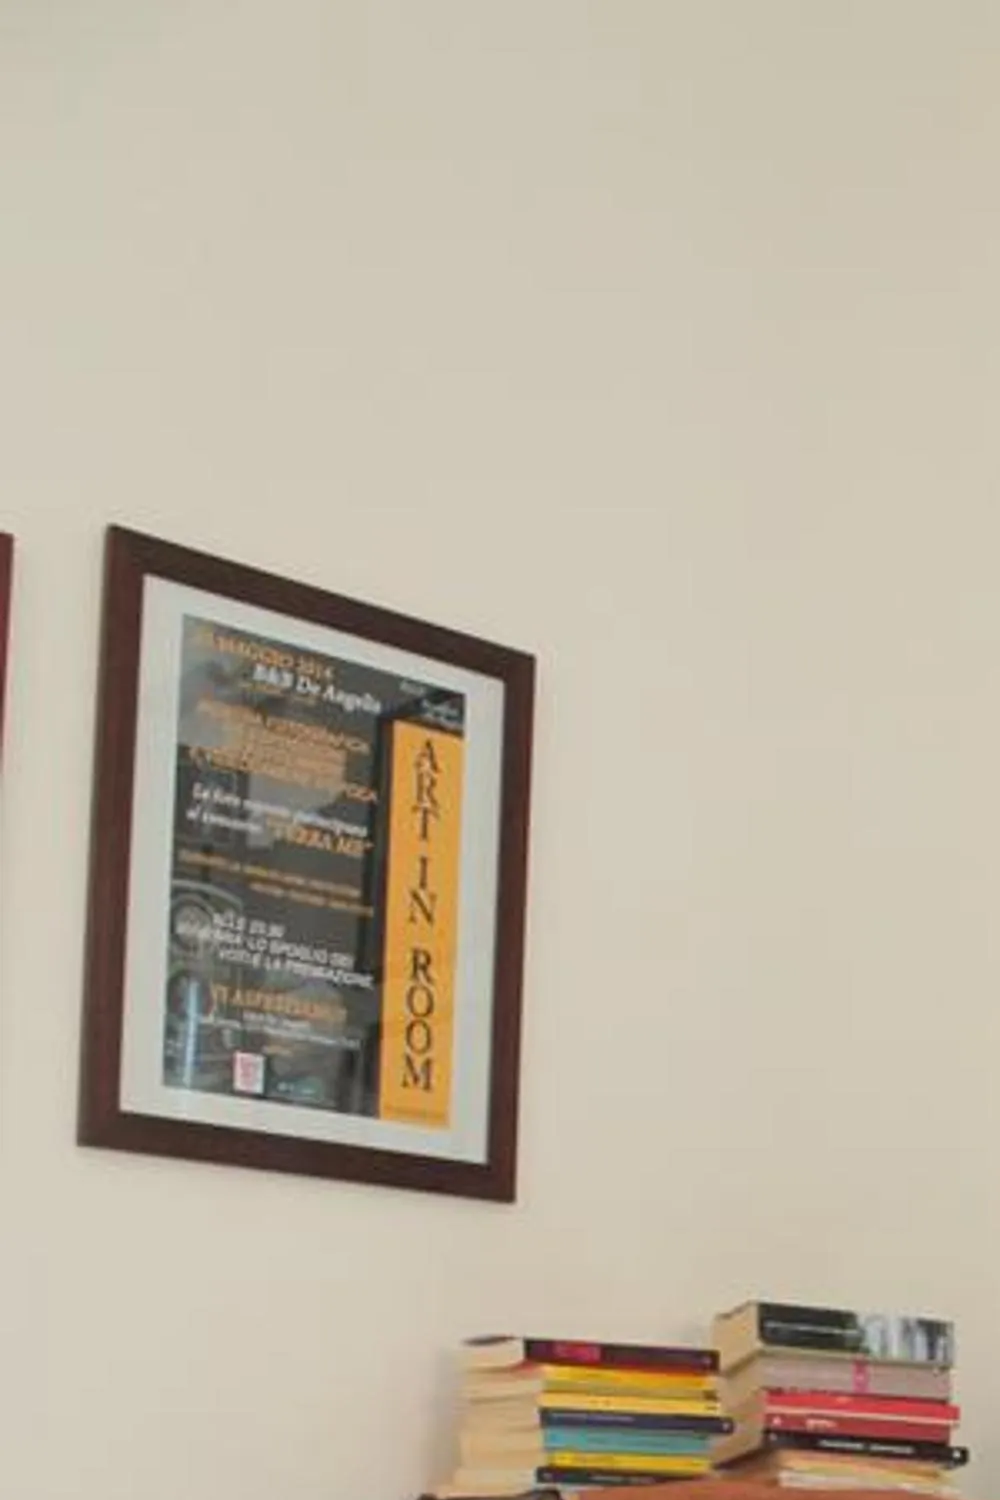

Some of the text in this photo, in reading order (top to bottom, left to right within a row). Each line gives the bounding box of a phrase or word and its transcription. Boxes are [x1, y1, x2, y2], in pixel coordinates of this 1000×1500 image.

[296, 675, 322, 693] De
[412, 740, 441, 841] ART
[409, 857, 437, 924] IN
[401, 948, 434, 1091] ROOM
